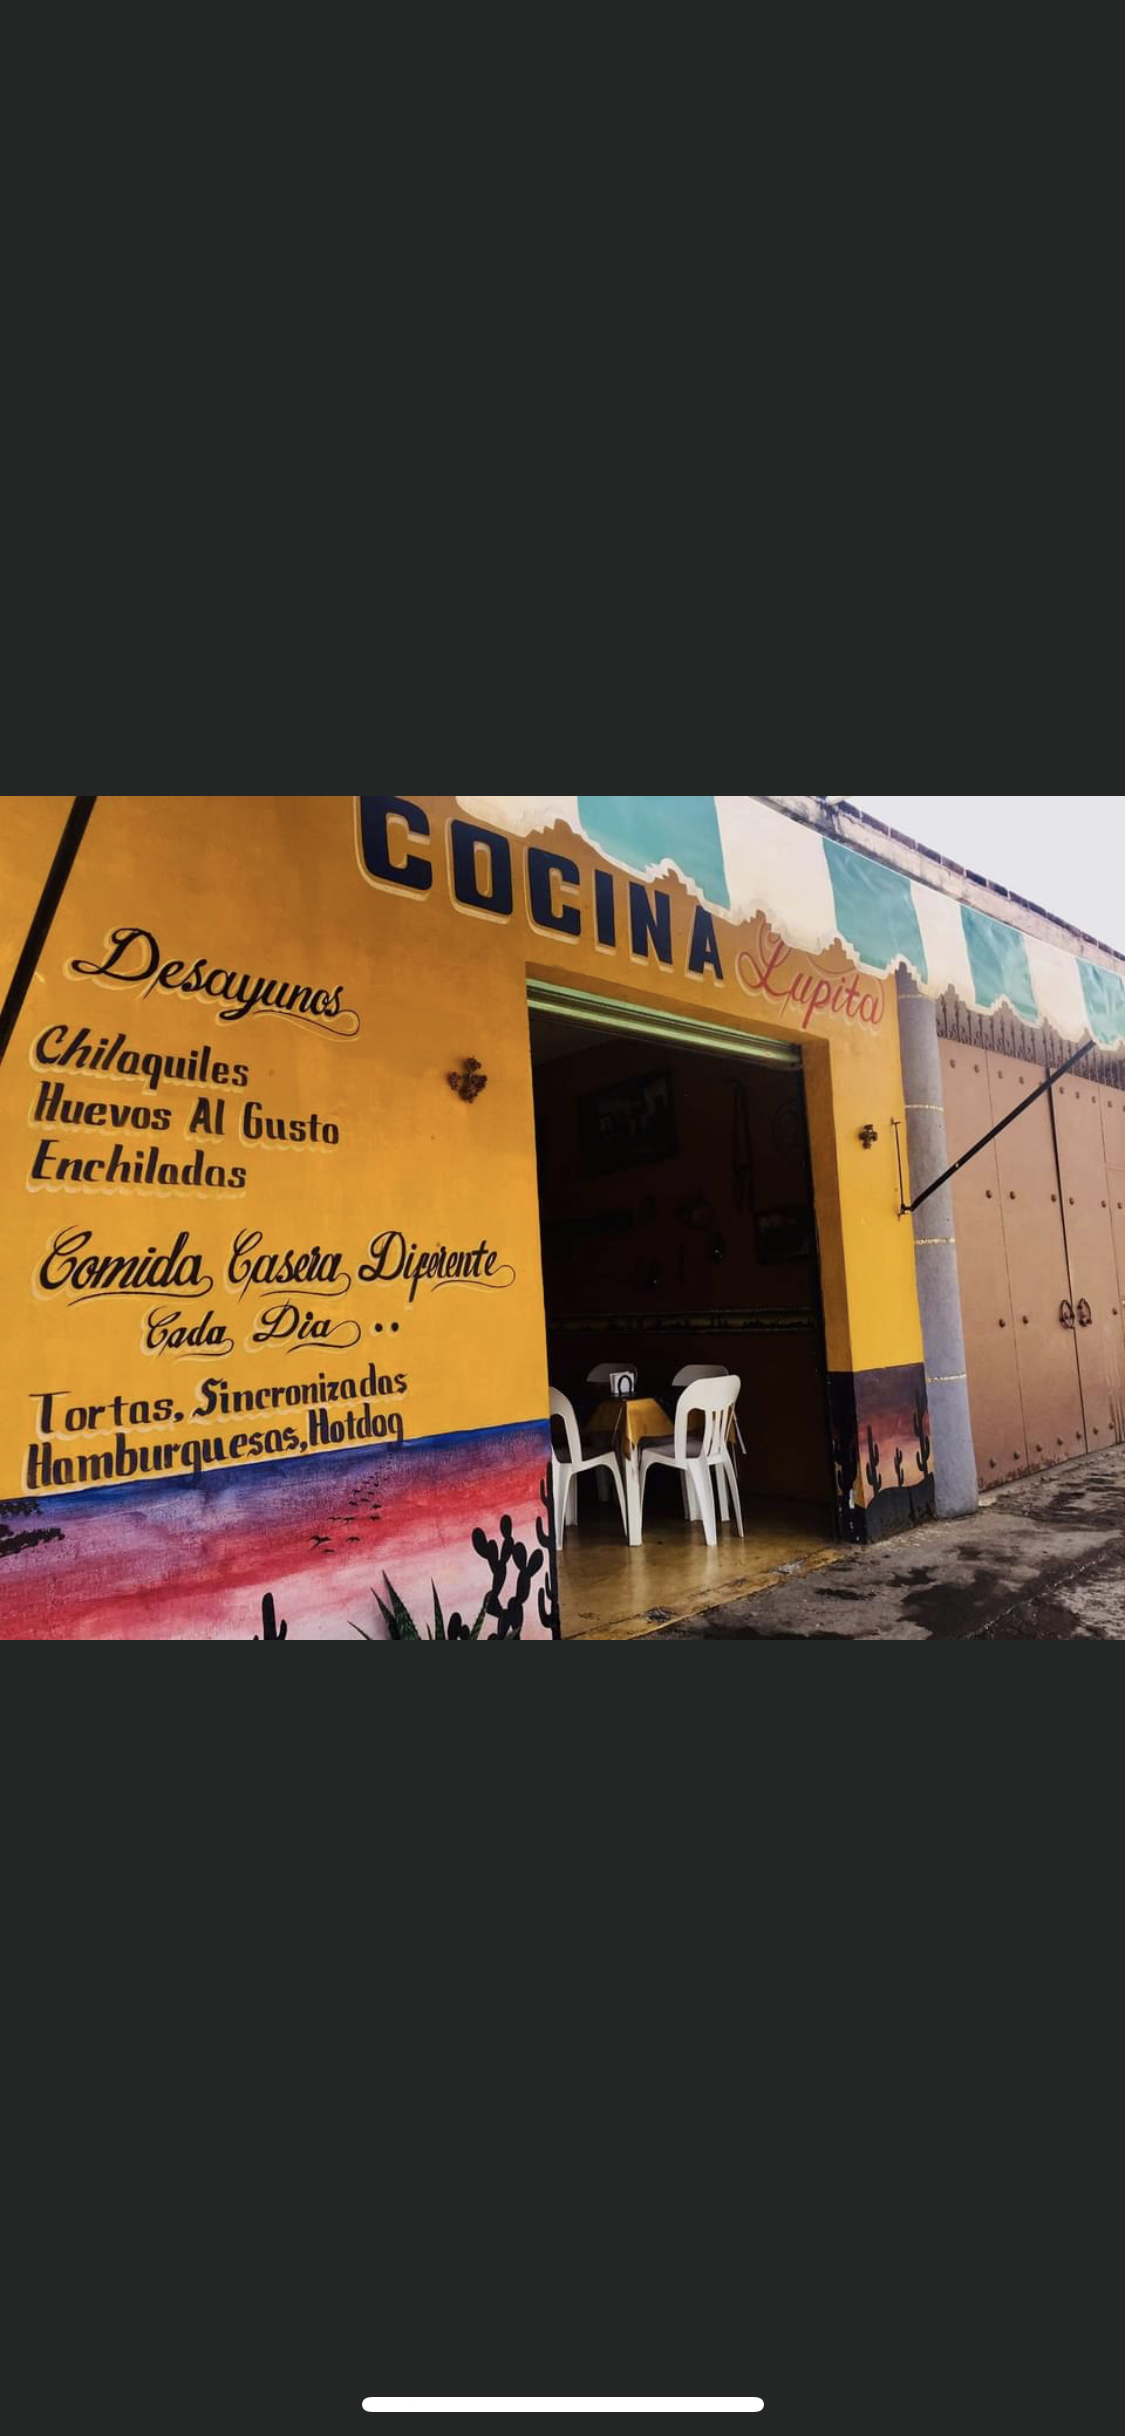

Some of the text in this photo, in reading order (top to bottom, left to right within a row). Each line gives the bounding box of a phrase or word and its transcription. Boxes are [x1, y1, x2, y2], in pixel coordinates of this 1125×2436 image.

[356, 796, 885, 1029] COCINA Lupita
[71, 927, 361, 1037] Desayunos
[35, 1025, 249, 1091] Chilaquiles
[33, 1081, 340, 1145] Huevos Al Gusto
[31, 1139, 247, 1189] Enchiladas
[39, 1225, 517, 1307] Comida Casera Diferente
[146, 1306, 234, 1357] Cada
[252, 1299, 362, 1354] Dia
[29, 1363, 409, 1434] Tortas, Sincronizadas
